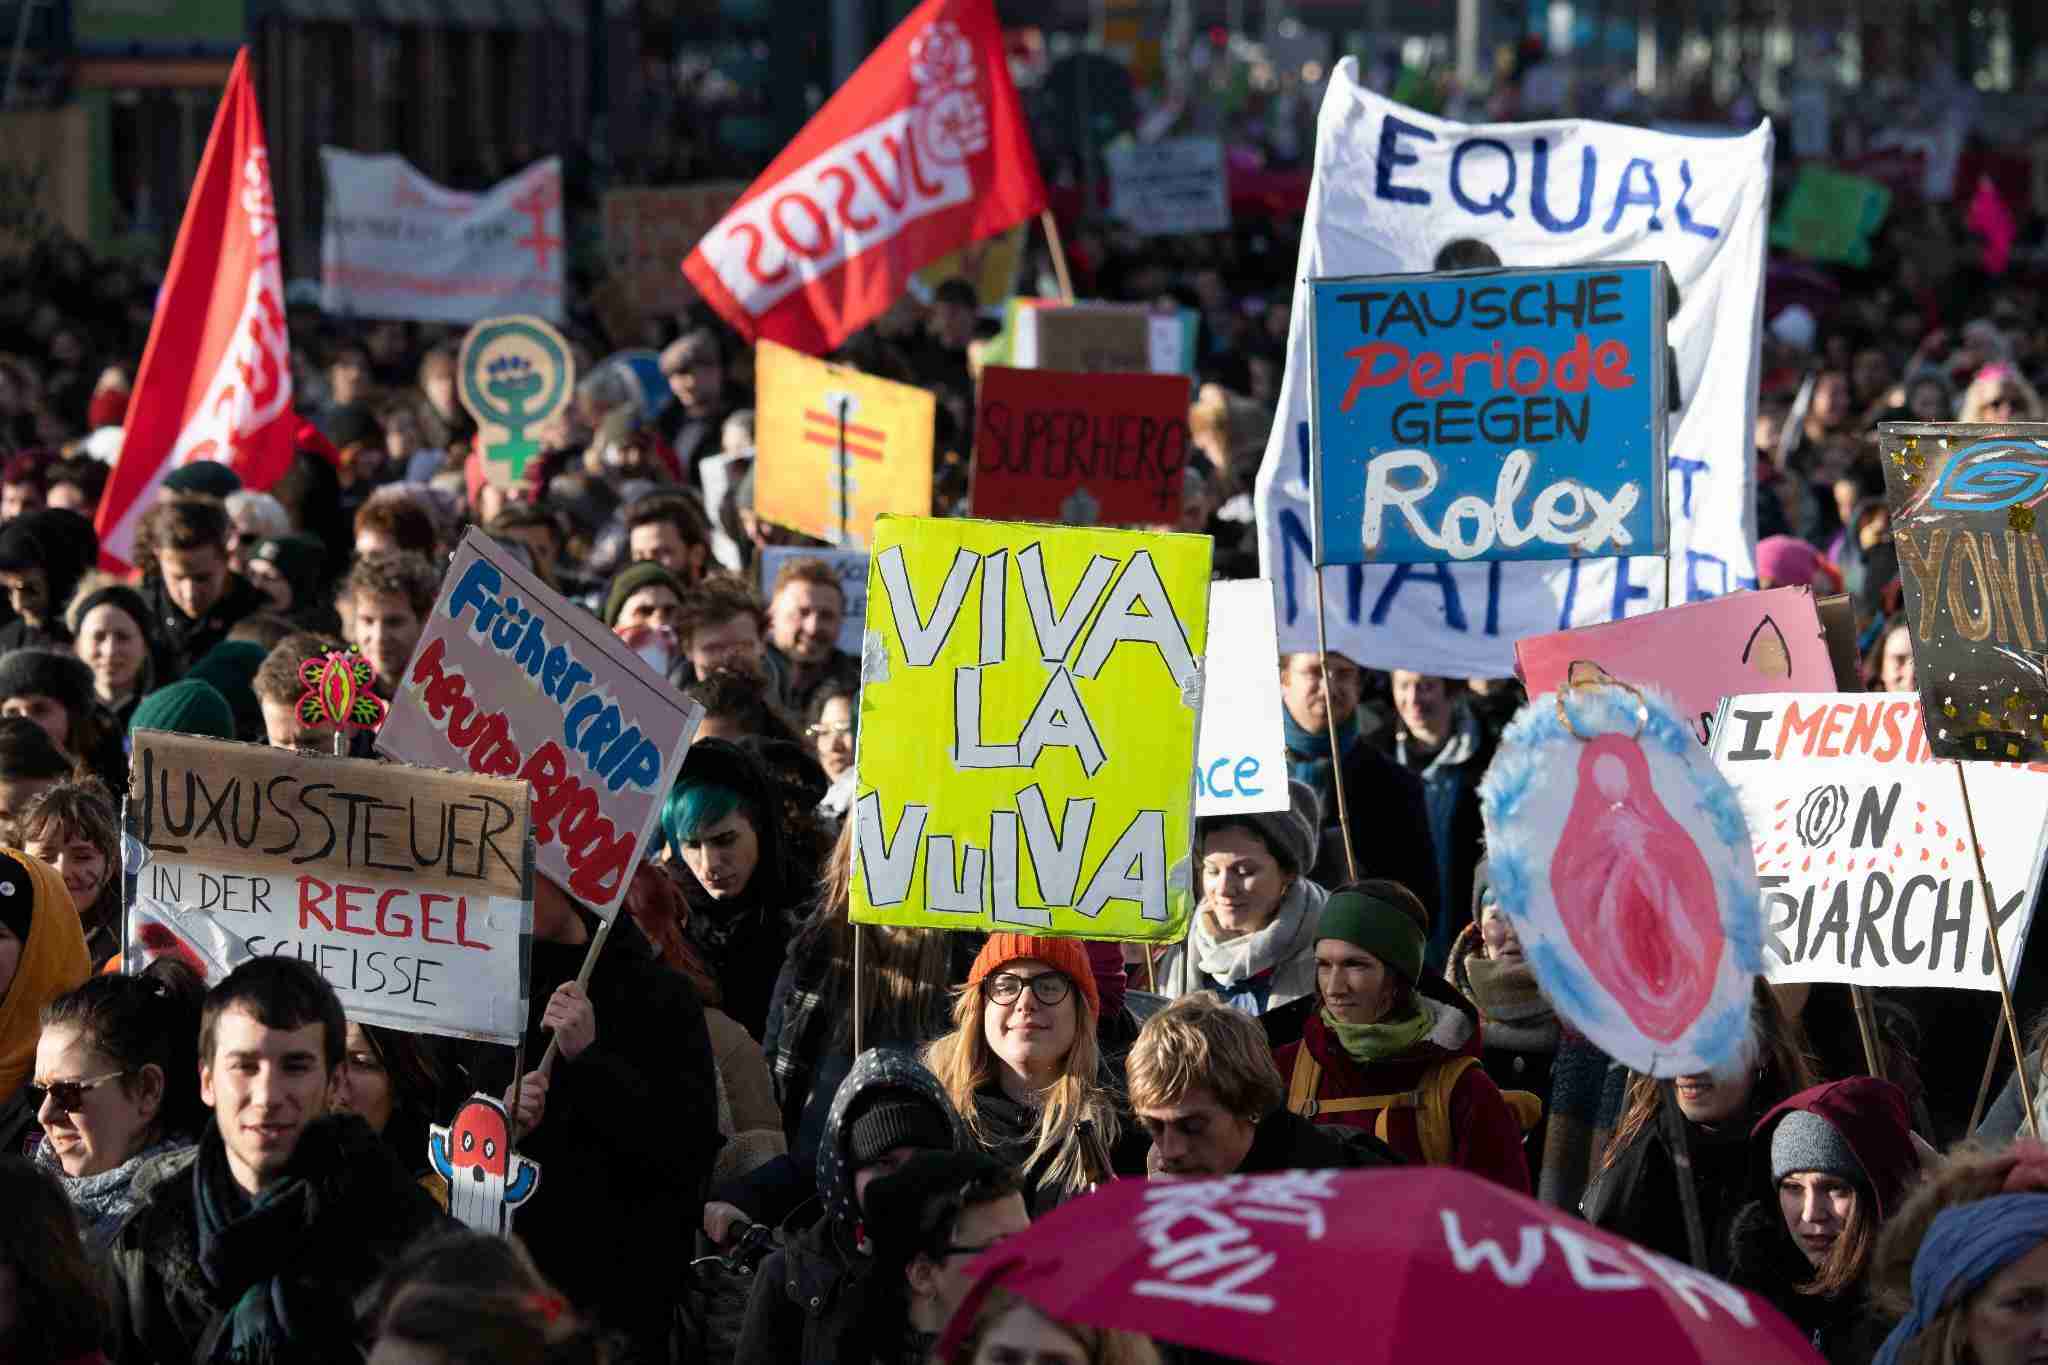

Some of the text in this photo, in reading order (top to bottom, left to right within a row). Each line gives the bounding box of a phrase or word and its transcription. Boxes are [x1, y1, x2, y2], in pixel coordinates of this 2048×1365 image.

[1375, 113, 1718, 239] EQUAL
[1336, 275, 1624, 337] TAUSCHE
[1339, 334, 1635, 412] Periode
[1391, 394, 1592, 447] GEGEN
[978, 401, 1189, 484] SUPERHERO
[1361, 448, 1641, 560] Rolex
[876, 541, 1199, 688] VIVA
[952, 665, 1107, 778] LA
[1728, 709, 1774, 761] I
[142, 747, 522, 884] LUXUSSTEUER
[152, 864, 493, 951] IN DER REGEL
[1756, 871, 2026, 976] RIARCHY
